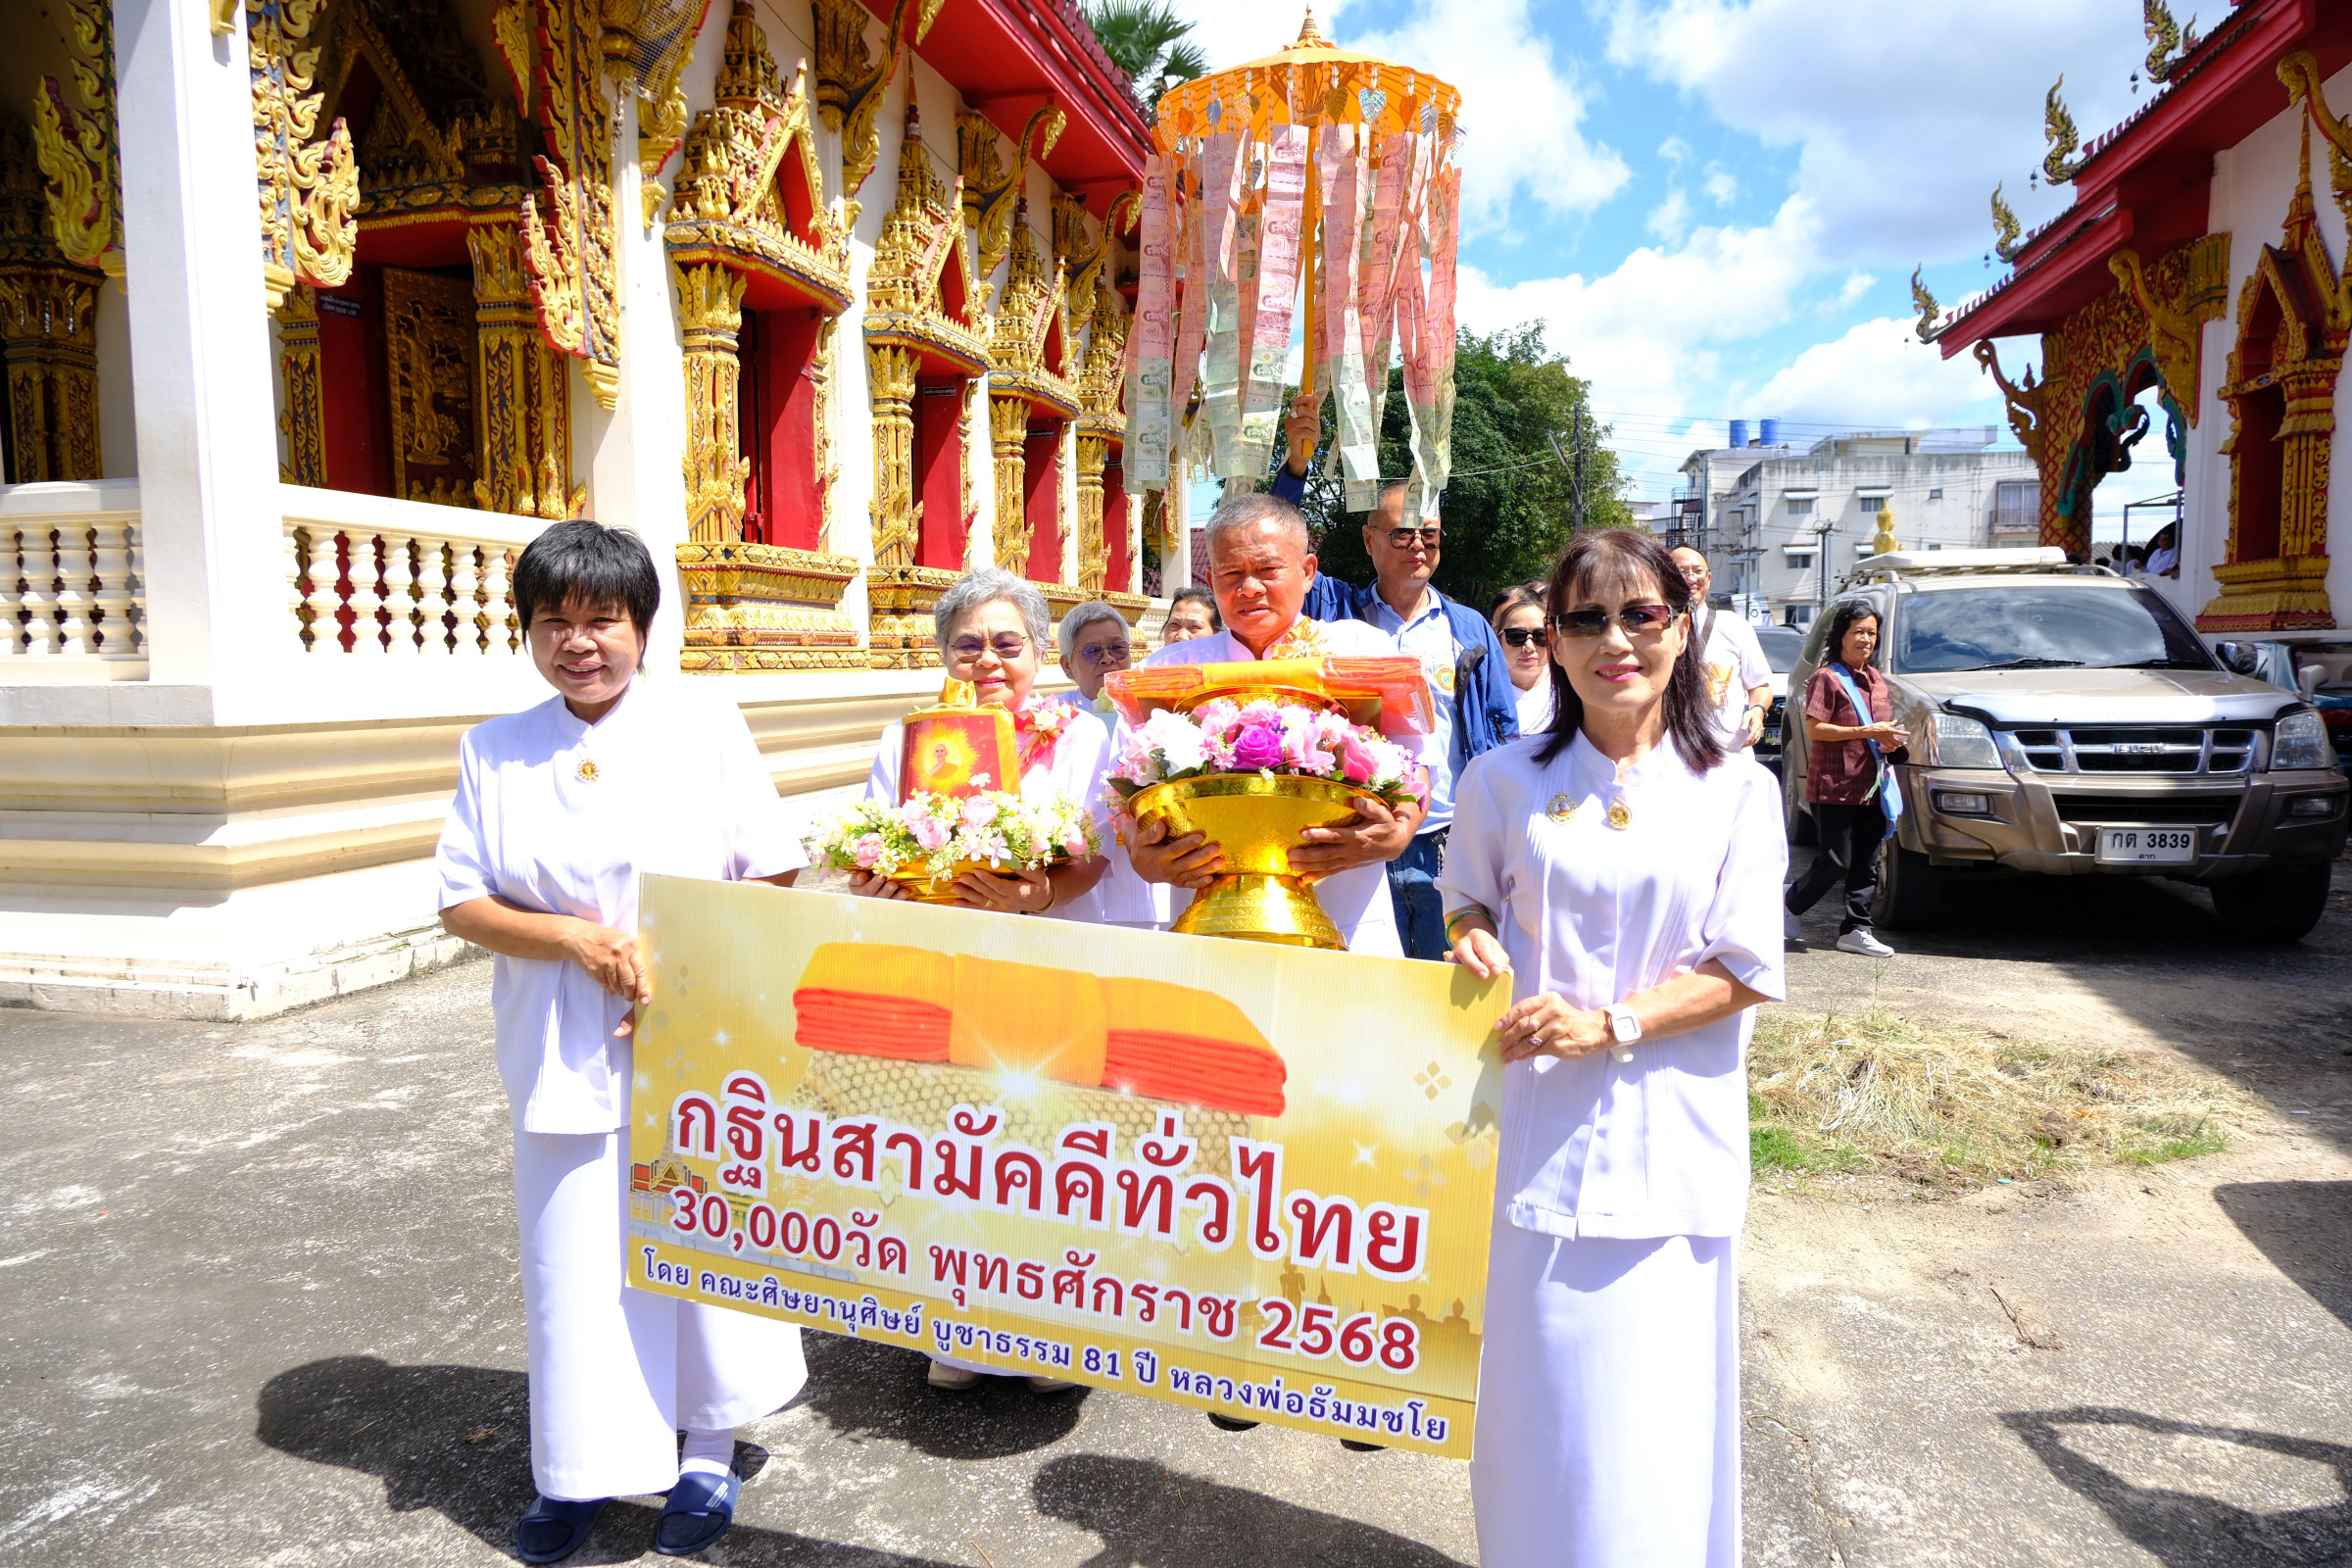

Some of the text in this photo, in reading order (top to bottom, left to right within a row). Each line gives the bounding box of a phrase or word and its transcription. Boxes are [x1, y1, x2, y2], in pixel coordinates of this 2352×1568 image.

[2114, 744, 2161, 754] ISUZU
[2146, 833, 2190, 849] 3839
[677, 1078, 1419, 1273] กฐินสามัคคีทั่วไทย
[643, 1247, 1446, 1441] โดย คณะศิษยานุศิษย์ บูชาธรรม 81 ปี หลวงพ่อธัมมชโย
[930, 1247, 1236, 1337] พุทธศักราช
[1260, 1299, 1415, 1369] 2568
